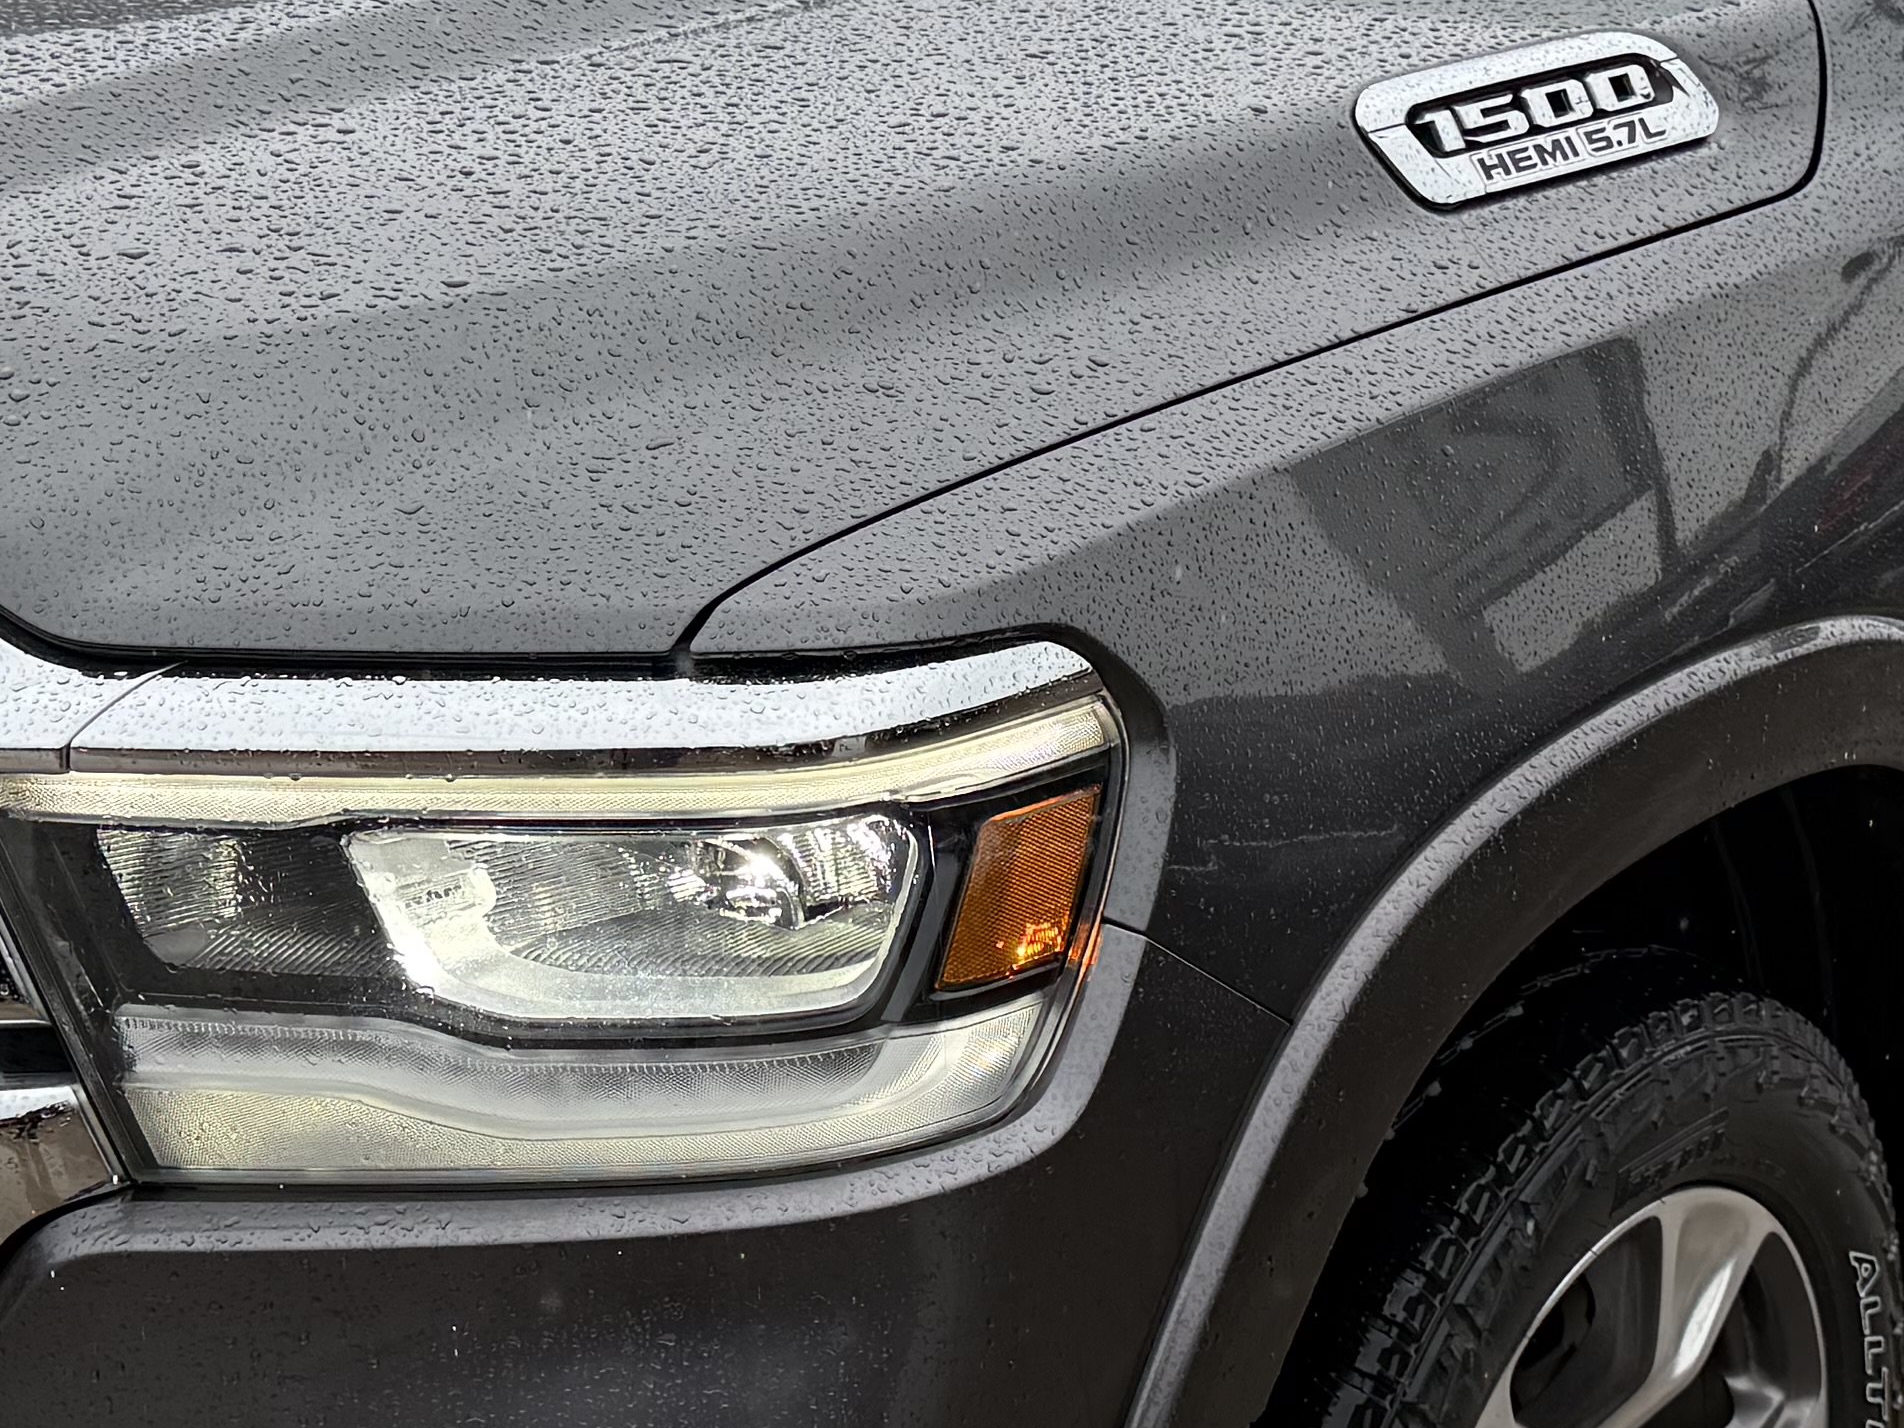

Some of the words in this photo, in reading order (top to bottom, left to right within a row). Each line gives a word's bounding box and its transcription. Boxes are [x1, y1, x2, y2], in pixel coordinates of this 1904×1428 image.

[1416, 63, 1656, 153] 1500
[1477, 136, 1581, 182] HEMI
[1584, 117, 1667, 155] 5.7L
